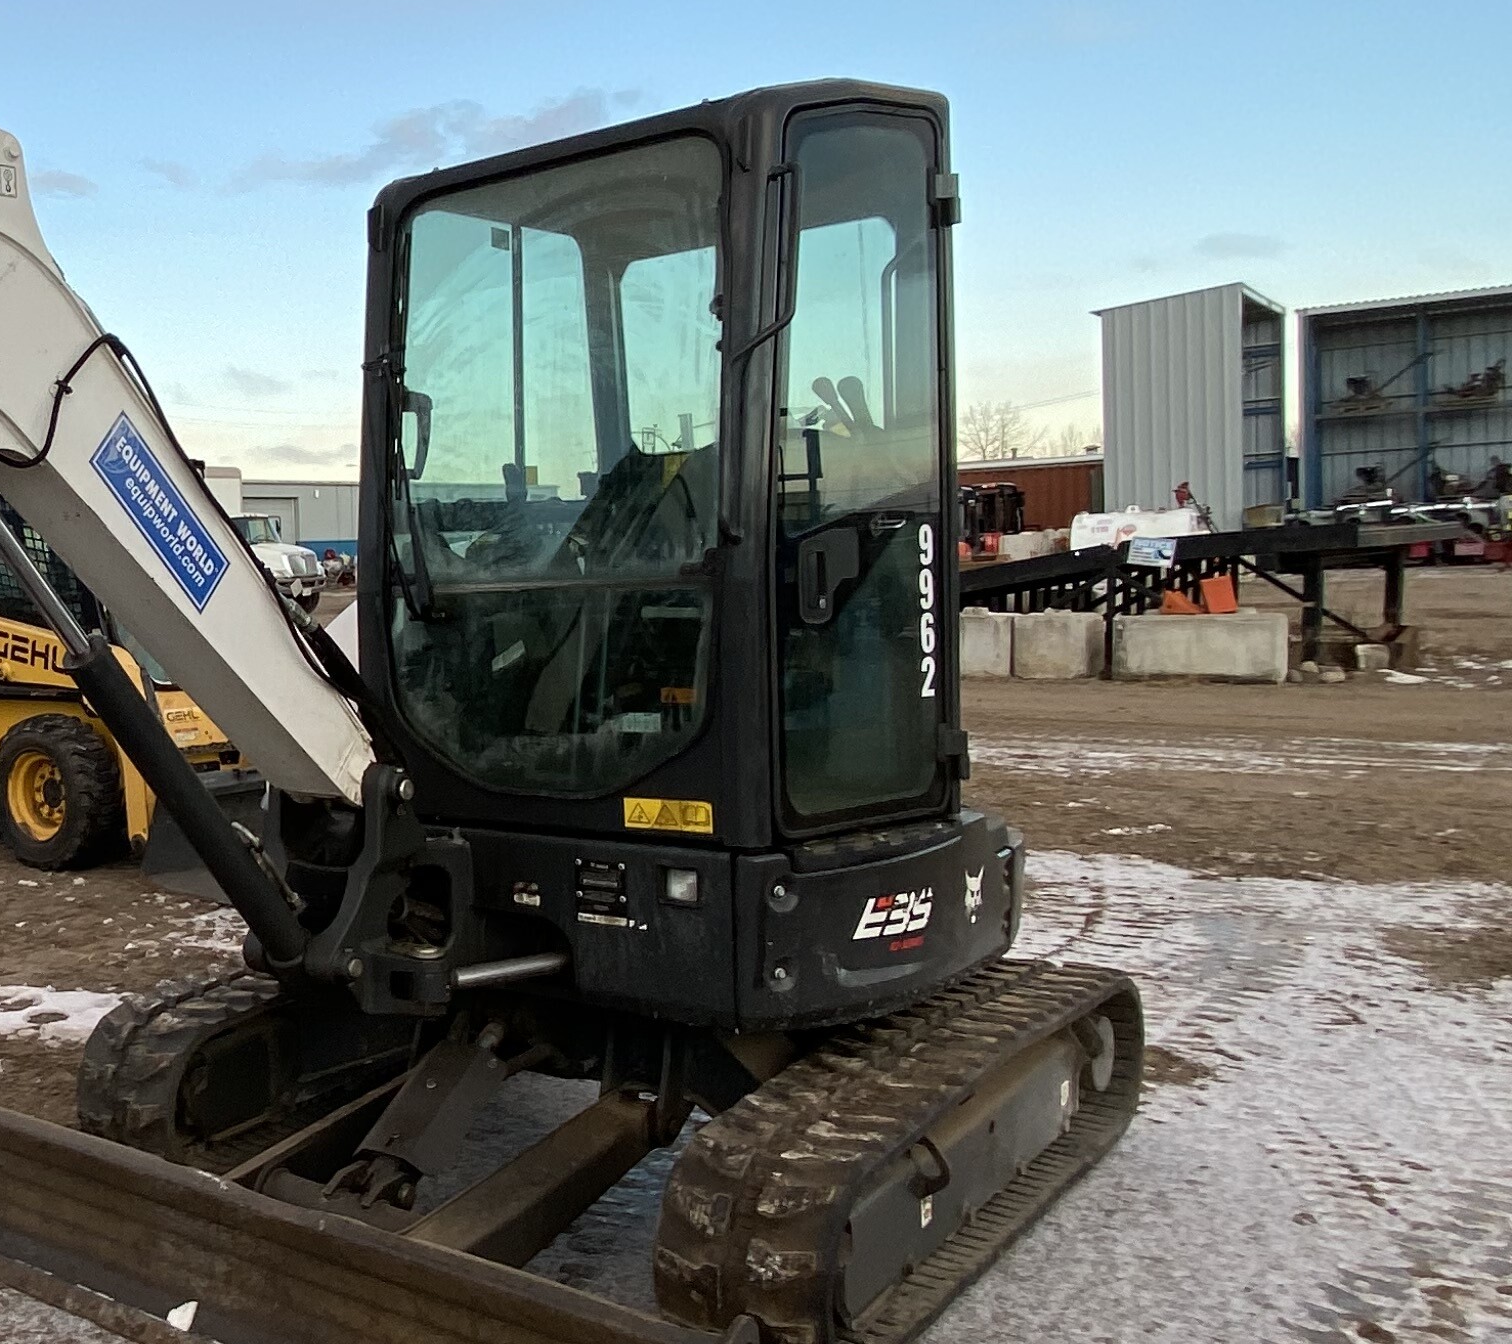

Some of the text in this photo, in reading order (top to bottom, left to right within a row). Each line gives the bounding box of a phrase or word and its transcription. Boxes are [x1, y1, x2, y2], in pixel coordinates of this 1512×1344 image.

[116, 436, 215, 576] EQUIPMENT WORLD
[125, 477, 206, 588] equipworld.com
[918, 523, 936, 698] 9962
[852, 887, 934, 941] E35
